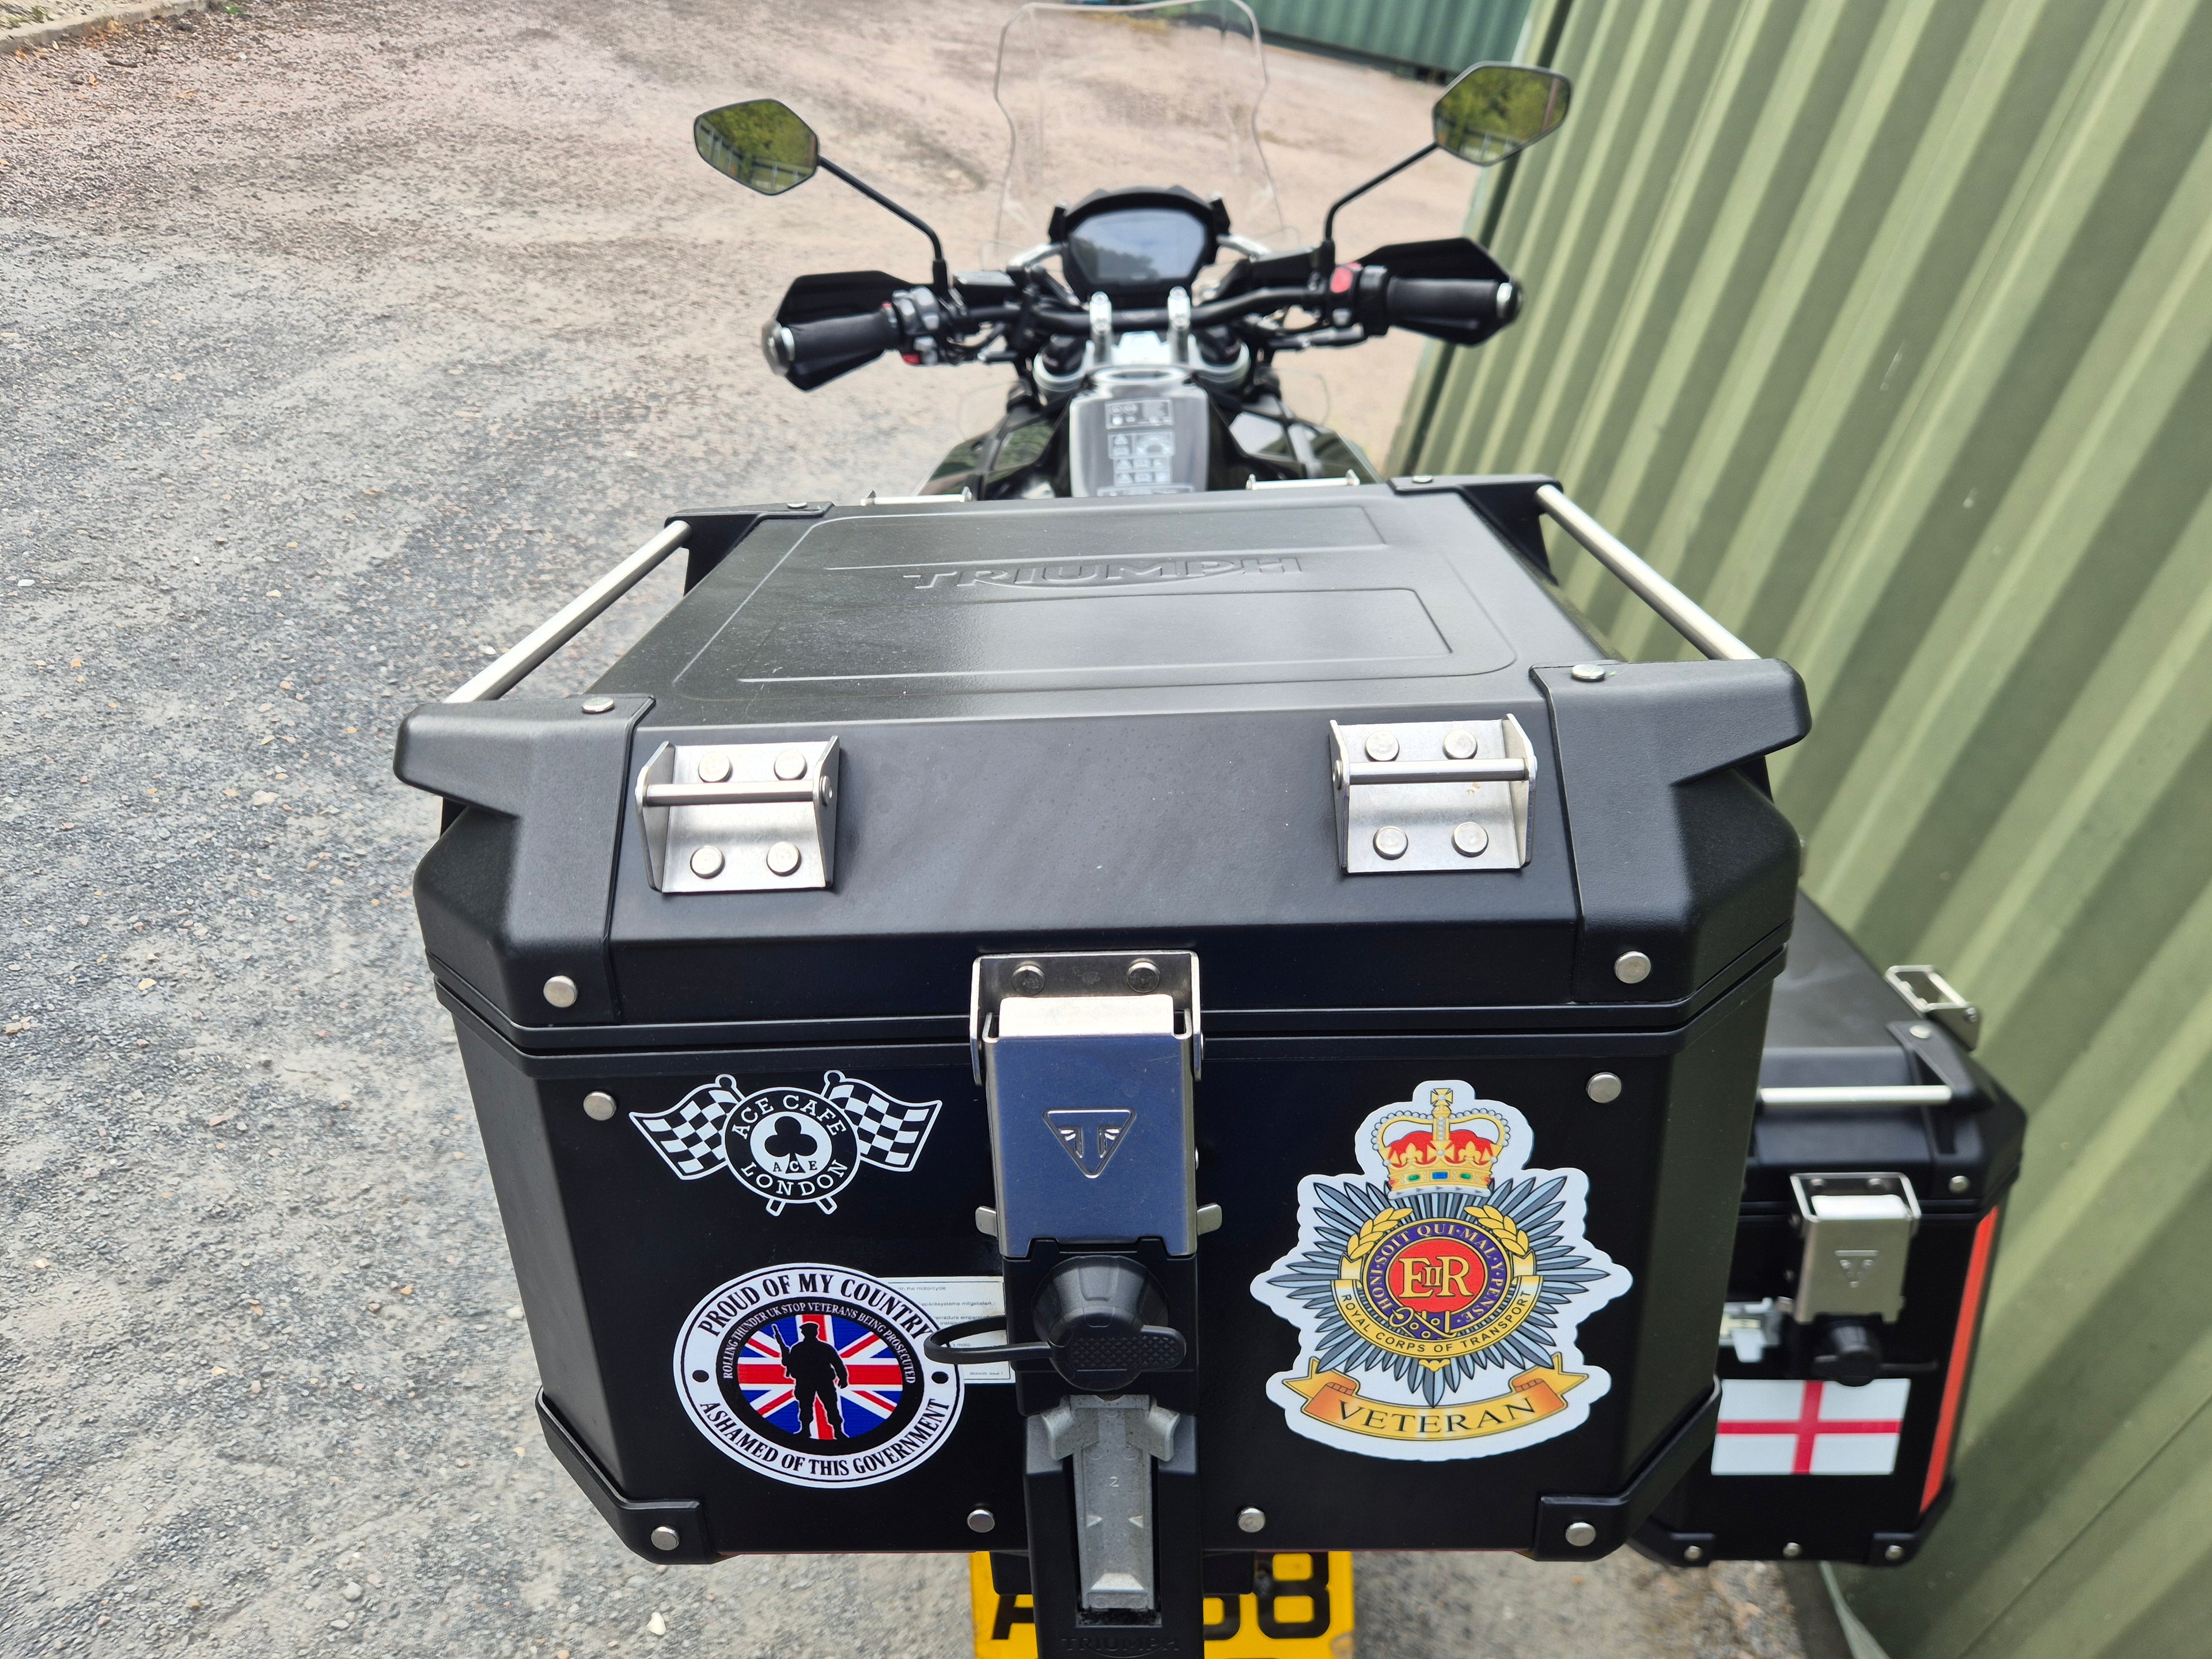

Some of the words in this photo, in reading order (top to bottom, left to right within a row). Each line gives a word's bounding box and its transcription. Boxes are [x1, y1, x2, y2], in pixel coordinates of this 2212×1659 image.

[903, 556, 1302, 589] TRIUMPH
[732, 1097, 774, 1139] ACE
[783, 1094, 847, 1136] CAFE
[741, 1159, 848, 1196] LONDON
[772, 1160, 818, 1172] ACE
[1375, 1231, 1411, 1265] SOIT
[698, 1286, 760, 1337] PROUD
[762, 1274, 791, 1297] OF
[798, 1273, 834, 1294] MY
[840, 1279, 933, 1340] COUNTRY
[1369, 1270, 1392, 1310] HONI
[1342, 1294, 1370, 1332] ROYAL
[1376, 1332, 1425, 1353] CORPS
[1434, 1343, 1453, 1353] OF
[1461, 1290, 1531, 1349] TRANSPORT
[722, 1338, 738, 1380] ROLLING
[732, 1312, 768, 1342] THUNDER
[766, 1306, 782, 1319] UK
[781, 1302, 806, 1314] STOP
[808, 1302, 858, 1319] VETERANS
[857, 1312, 887, 1333] BEING
[883, 1330, 916, 1384] PROSECUTED
[1338, 1396, 1536, 1433] VETERAN
[700, 1402, 778, 1462] ASHAMED
[781, 1454, 805, 1472] OF
[808, 1459, 850, 1476] THIS
[853, 1398, 951, 1474] GOVERNMENT
[1061, 1638, 1180, 1652] TRIUMPH
